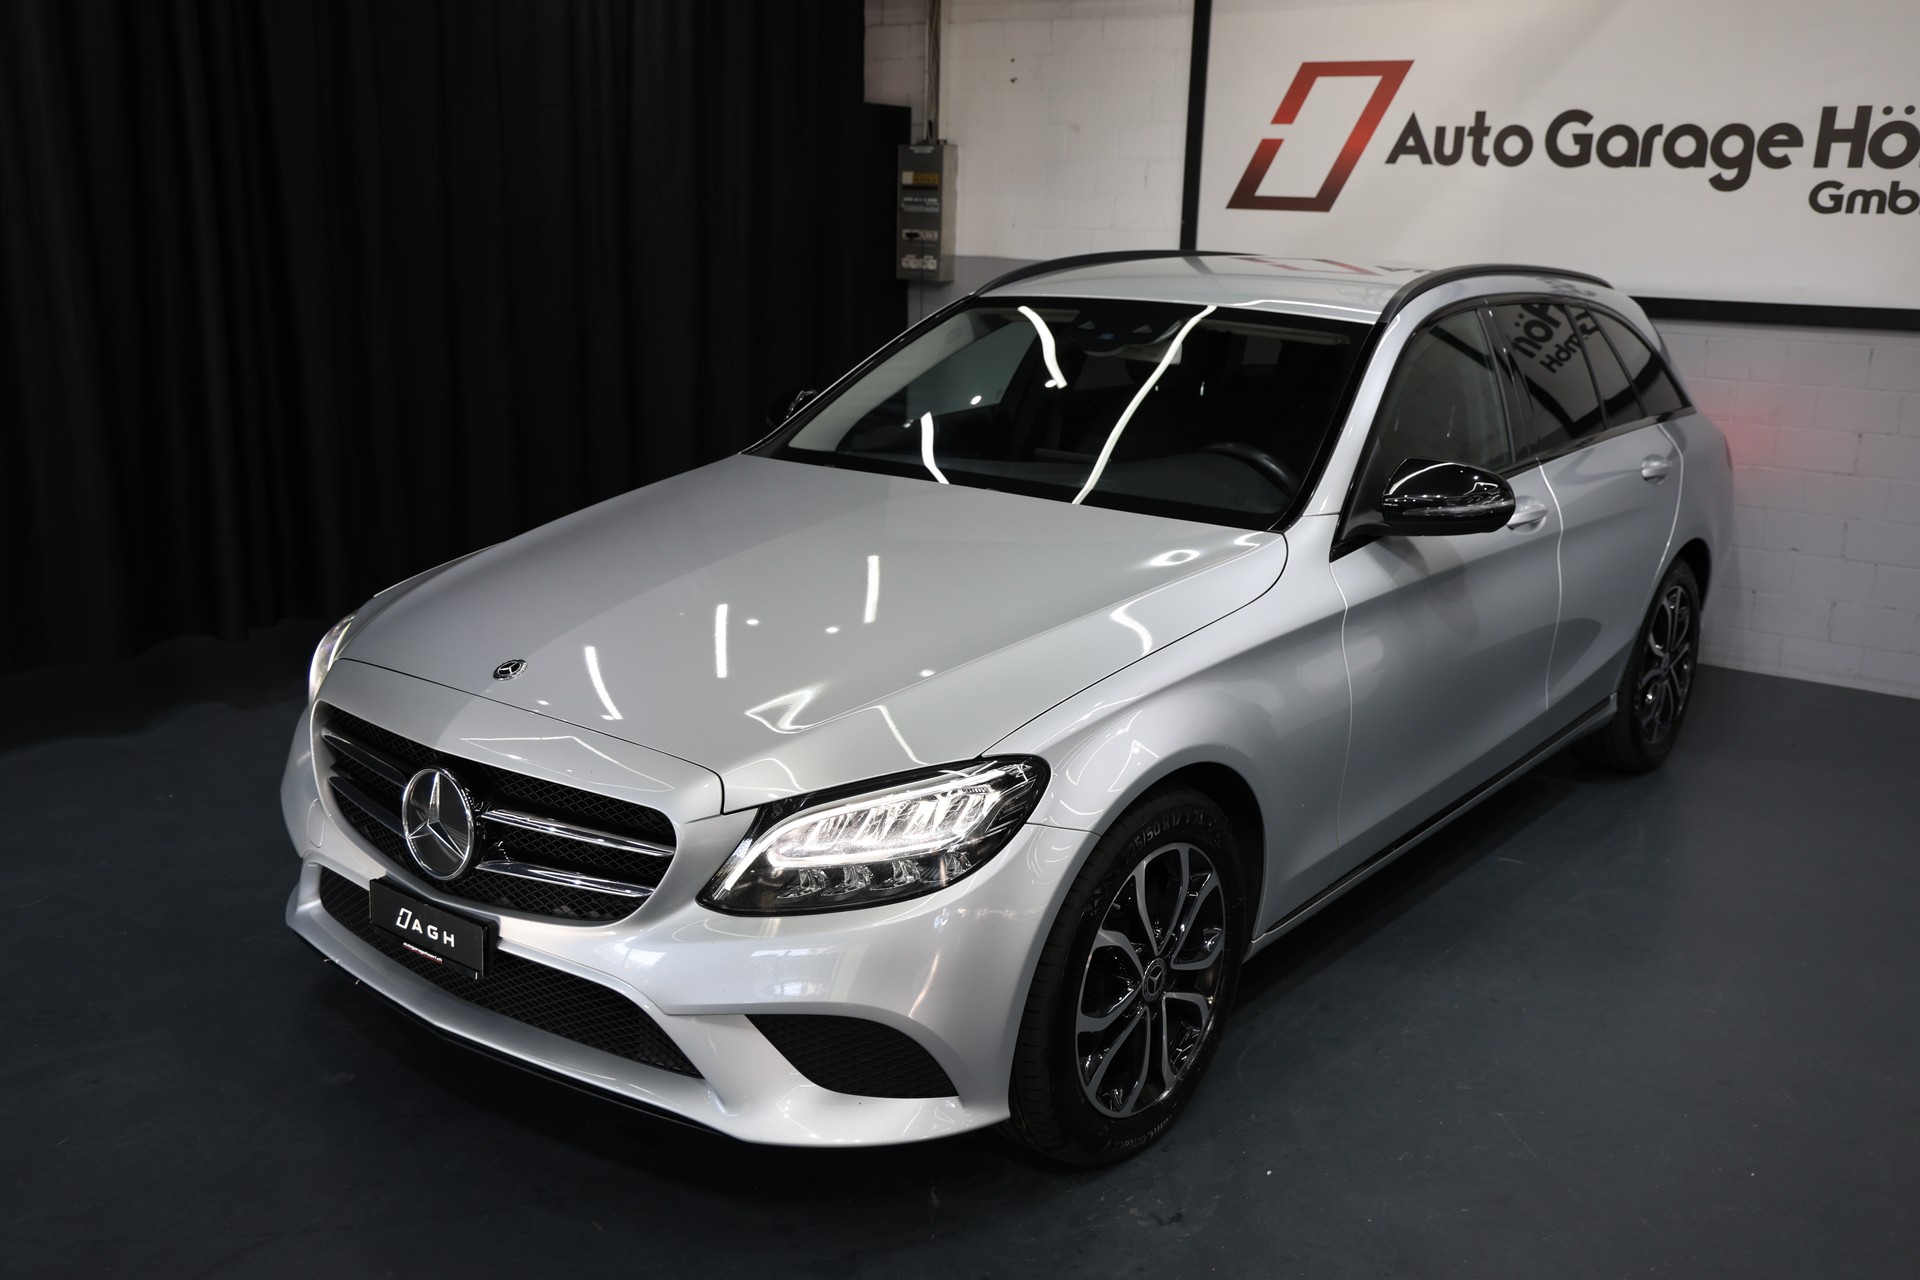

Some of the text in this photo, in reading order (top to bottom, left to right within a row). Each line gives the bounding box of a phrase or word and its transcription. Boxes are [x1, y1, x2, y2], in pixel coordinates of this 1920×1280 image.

[1385, 104, 1920, 193] Auto Garage Hö
[1808, 180, 1920, 216] Gmb
[411, 918, 455, 948] AGH
